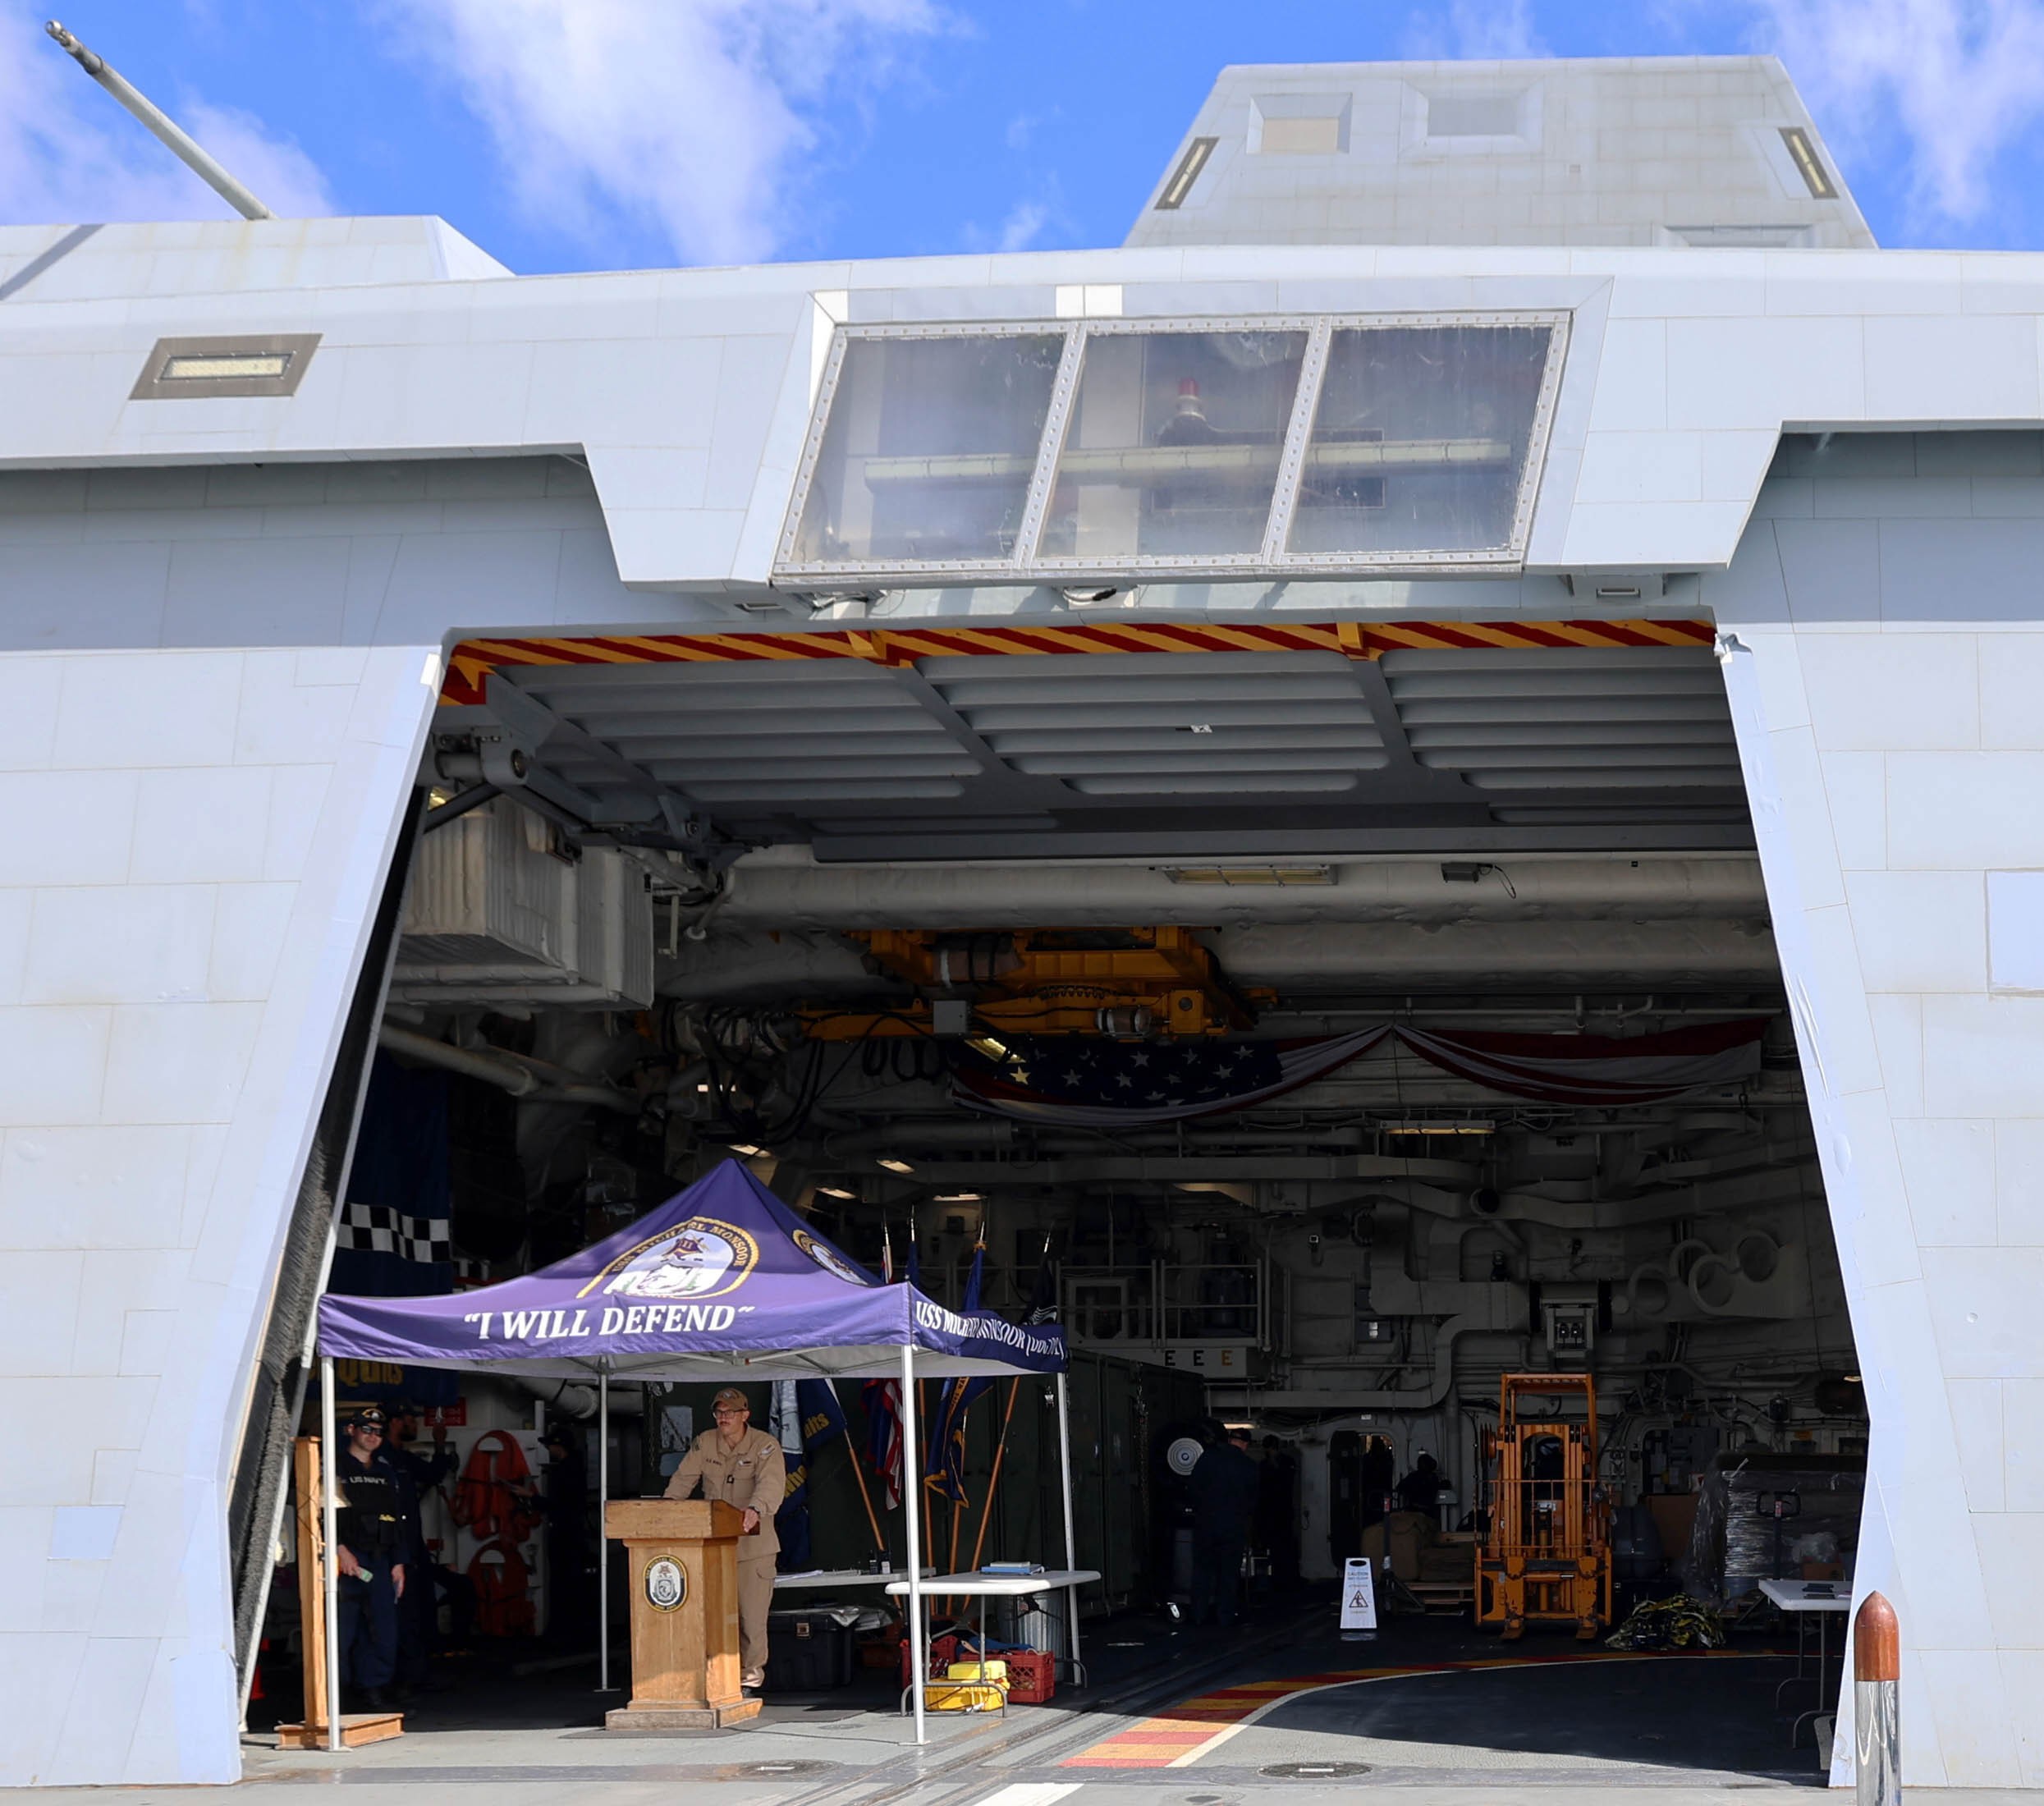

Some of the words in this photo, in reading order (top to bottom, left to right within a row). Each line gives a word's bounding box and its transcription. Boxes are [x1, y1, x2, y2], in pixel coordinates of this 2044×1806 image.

[709, 1226, 748, 1266] MONSOOR
[464, 1311, 493, 1340] “I
[502, 1309, 591, 1340] WILL
[598, 1305, 756, 1336] DEFEND”
[915, 1300, 942, 1330] USS
[1166, 1350, 1176, 1366] E
[1194, 1350, 1204, 1366] E
[1221, 1350, 1233, 1367] E
